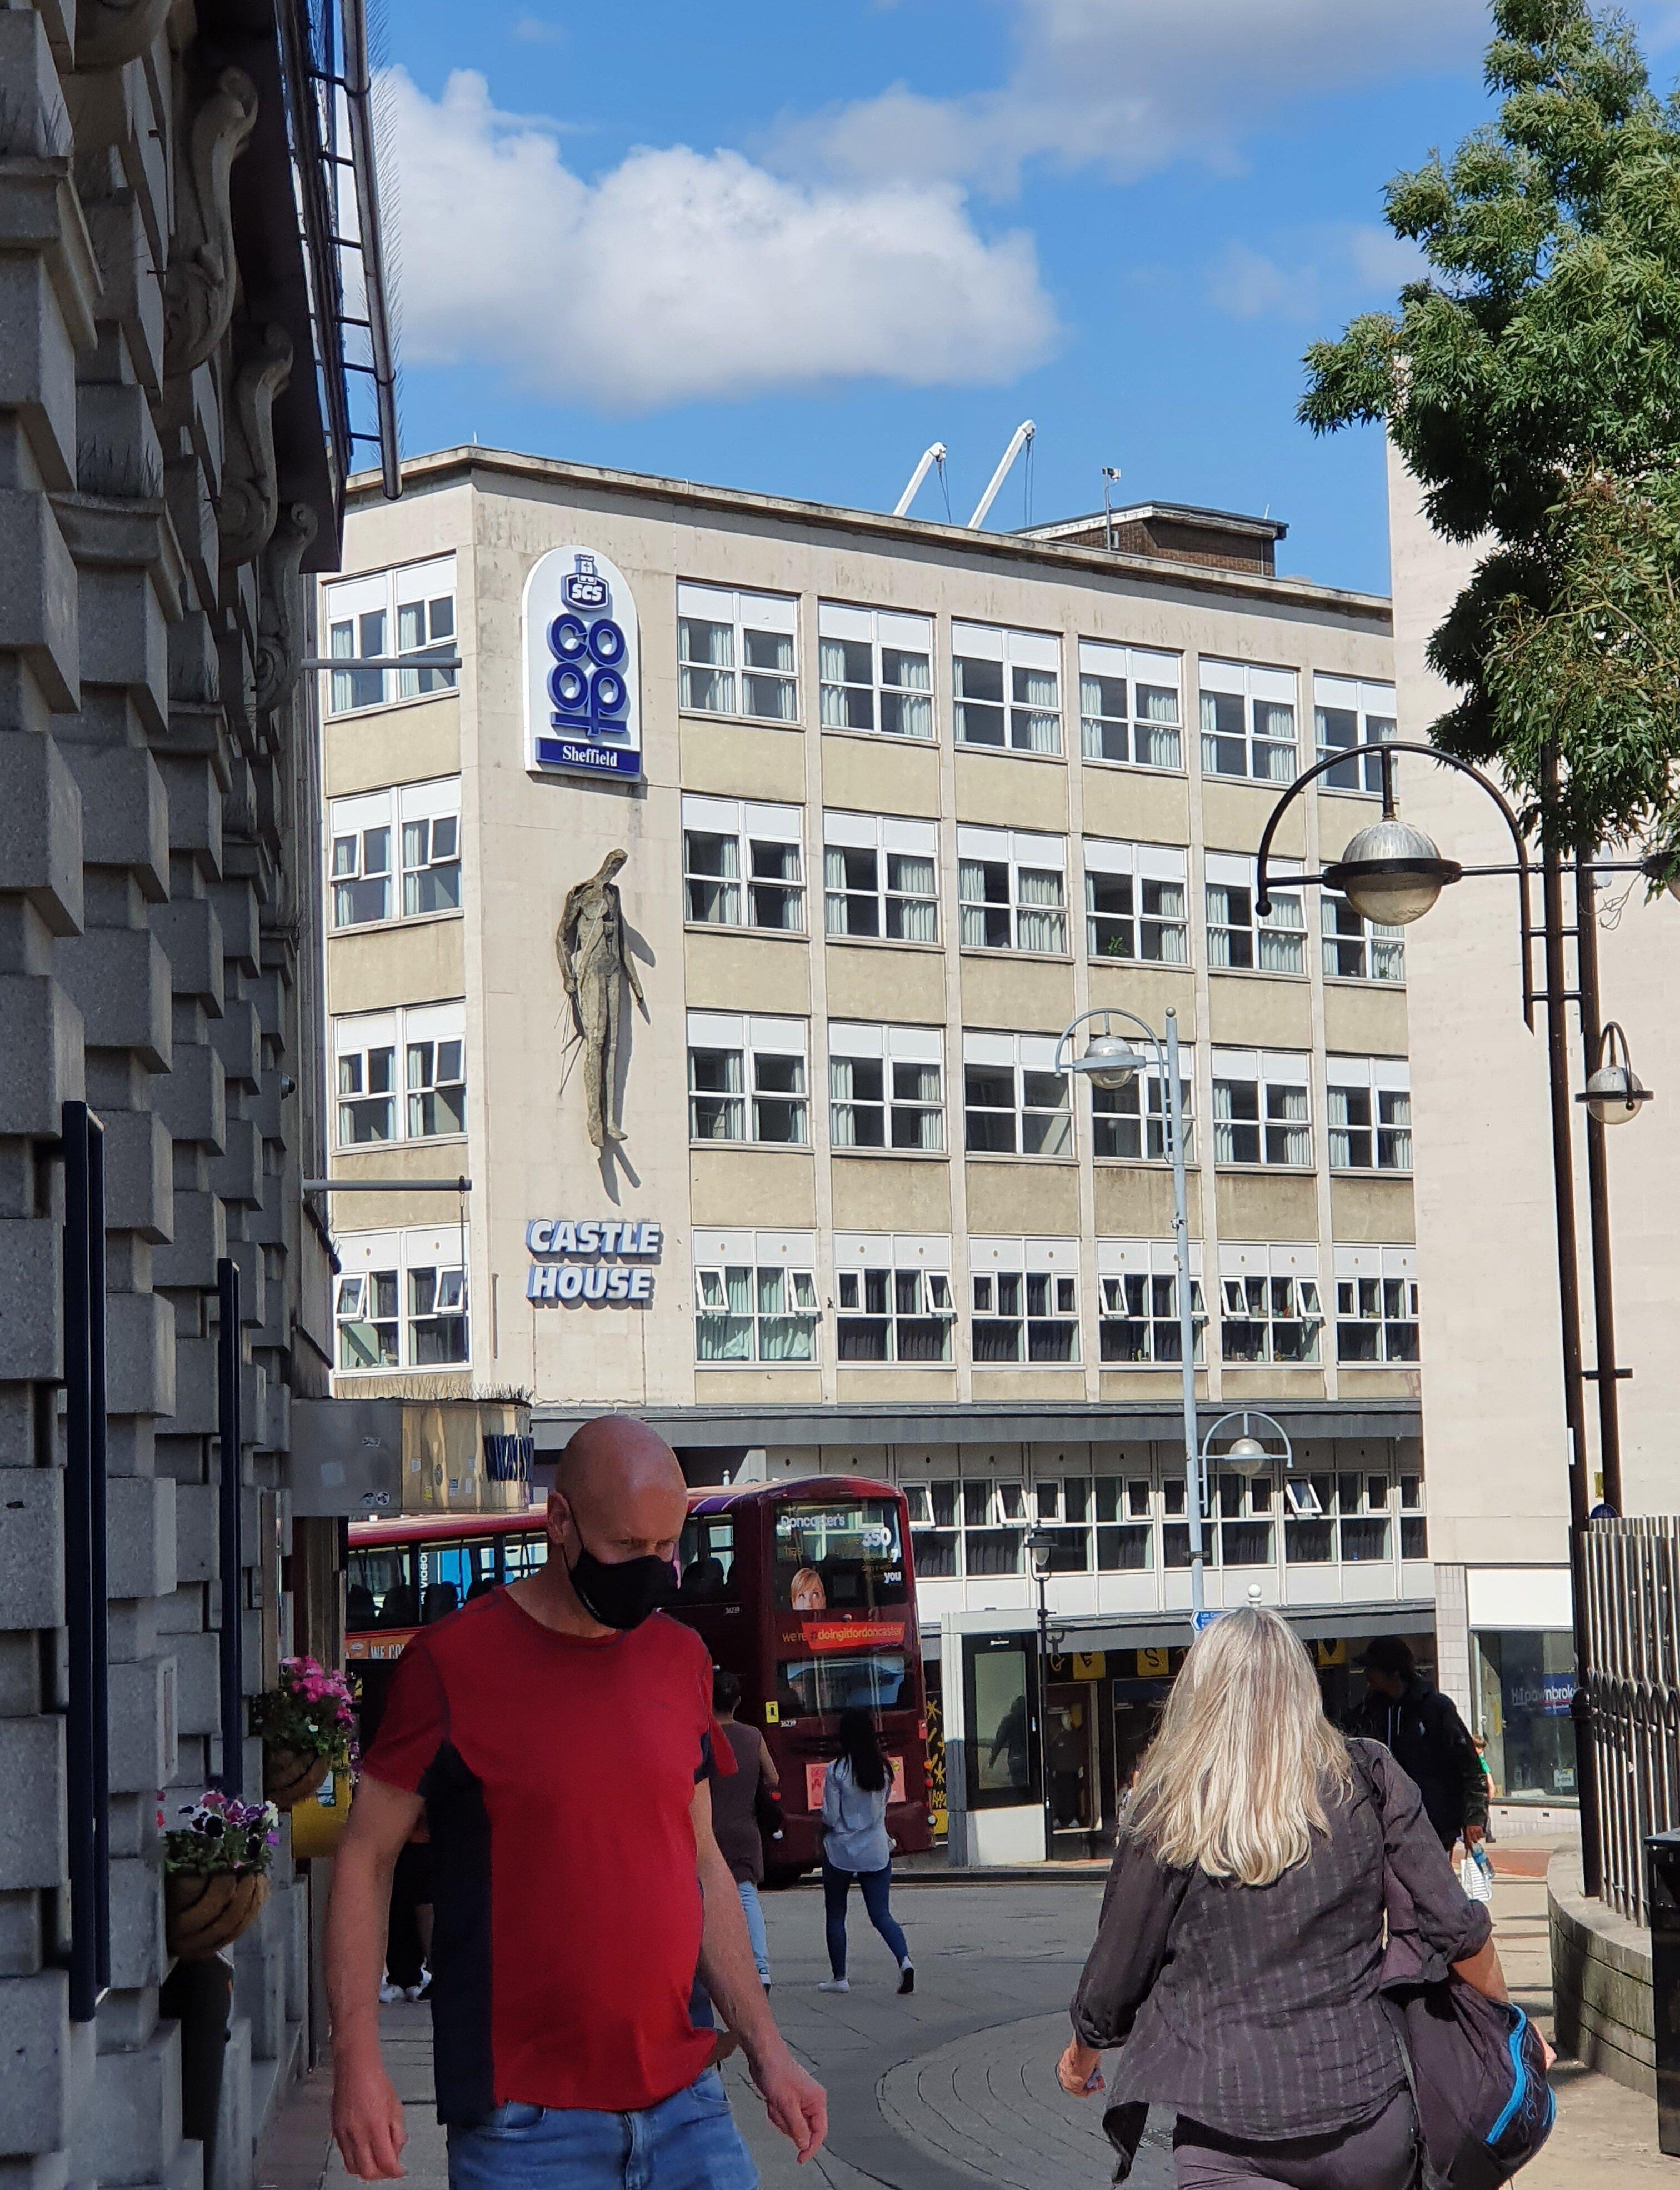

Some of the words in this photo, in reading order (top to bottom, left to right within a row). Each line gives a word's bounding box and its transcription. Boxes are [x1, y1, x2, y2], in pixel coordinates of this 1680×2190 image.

[572, 583, 603, 601] SCS
[562, 745, 617, 767] Sheffield
[526, 1219, 661, 1253] CASTLE
[527, 1265, 652, 1299] HOUSE
[780, 1515, 846, 1528] Doncaster's
[862, 1527, 892, 1547] 350
[884, 1572, 902, 1584] you
